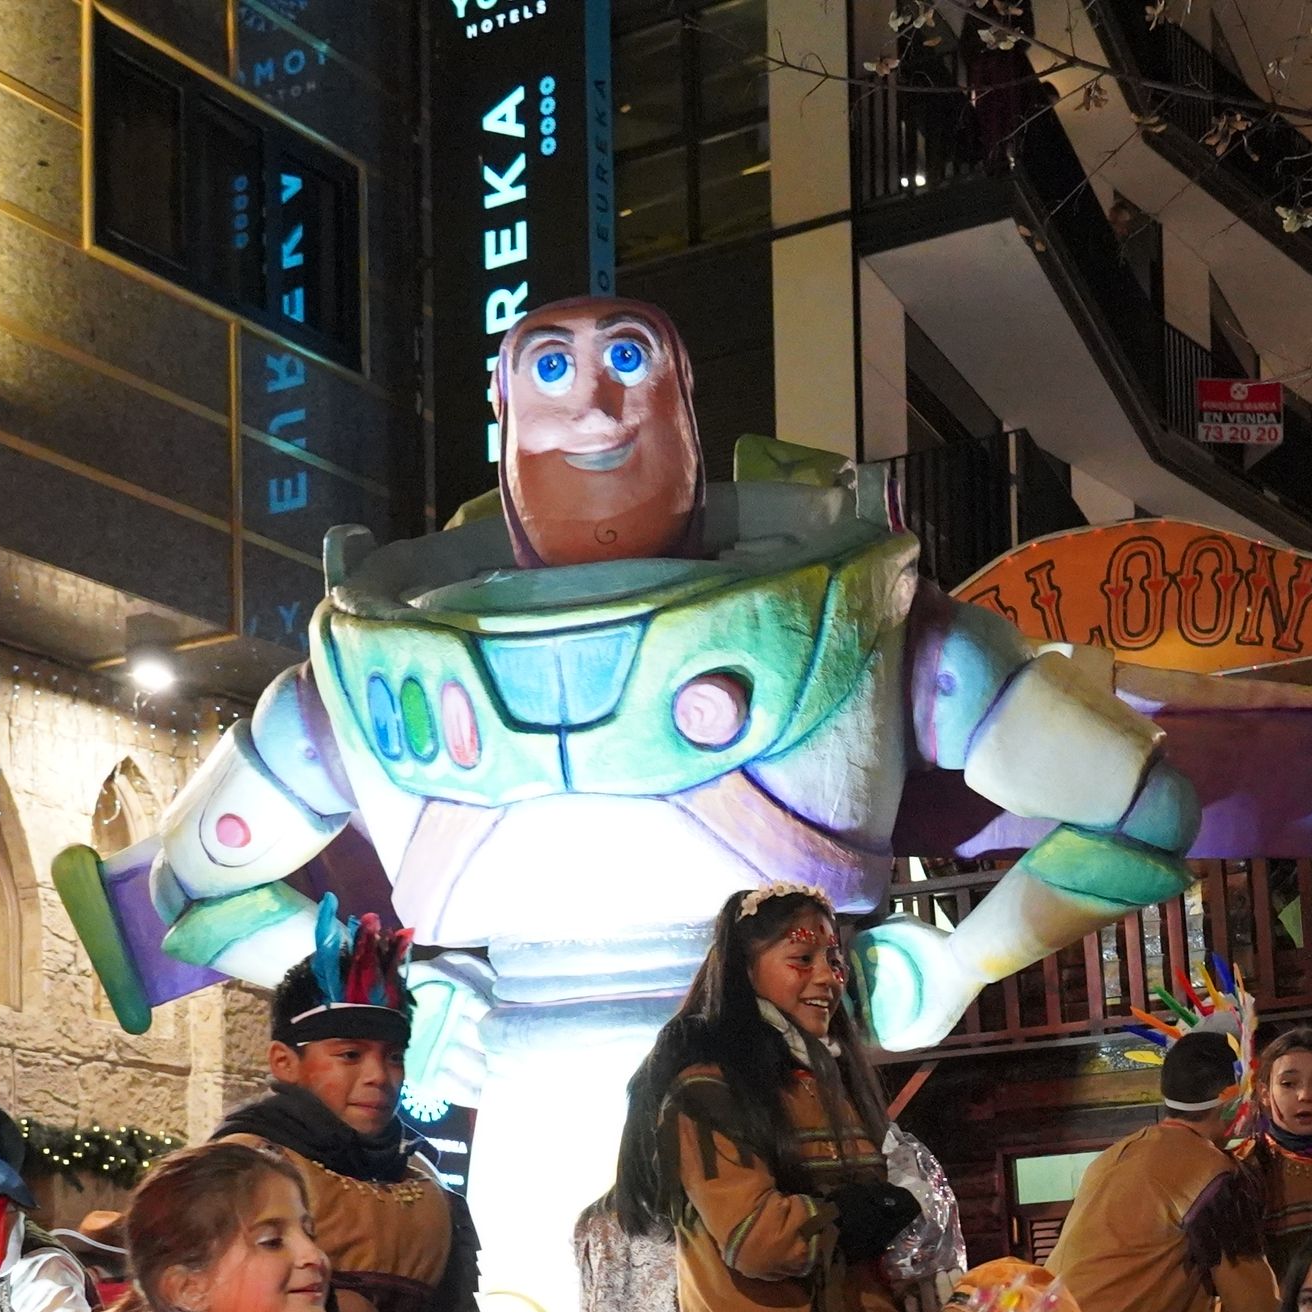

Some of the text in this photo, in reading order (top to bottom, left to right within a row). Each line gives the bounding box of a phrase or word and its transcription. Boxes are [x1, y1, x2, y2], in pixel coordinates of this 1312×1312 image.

[465, 0, 548, 39] HOTELS
[593, 78, 610, 243] EUREKA
[482, 84, 529, 463] REKA
[1201, 425, 1278, 442] 73 20 20
[1203, 412, 1278, 424] EN VENDA
